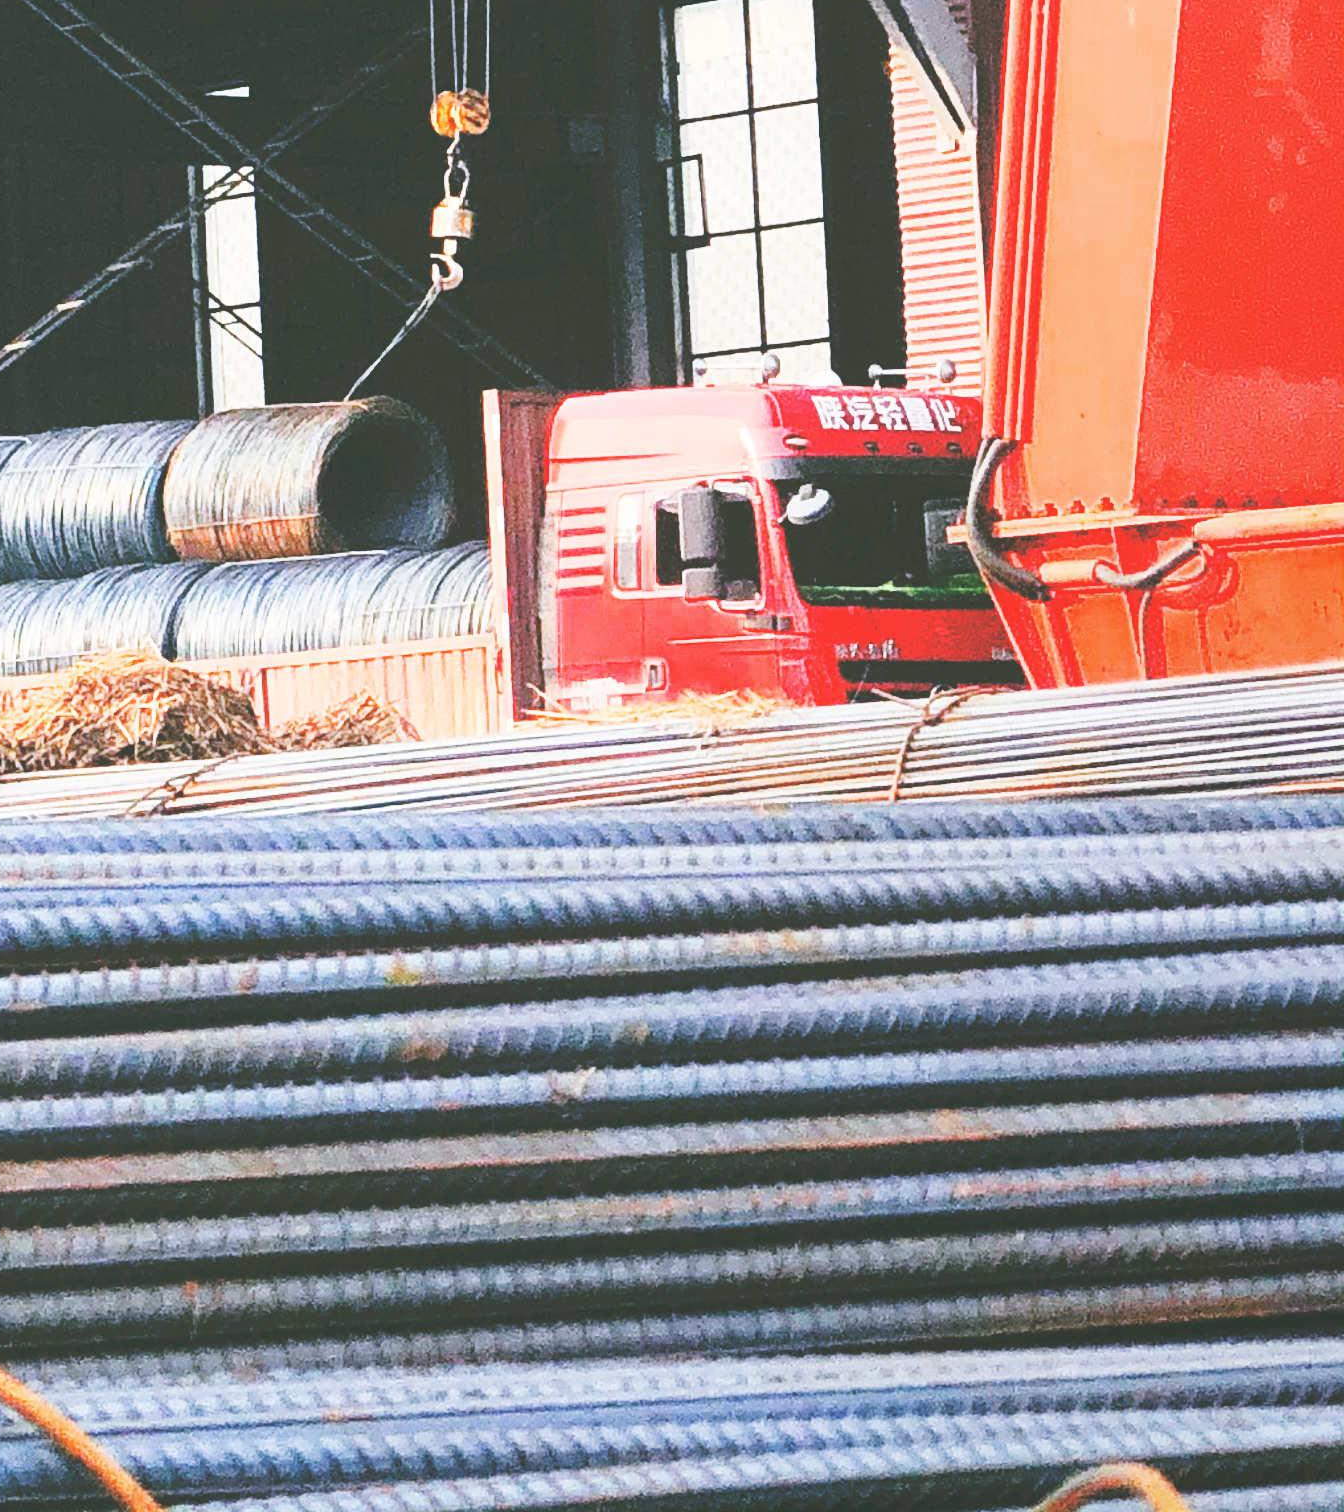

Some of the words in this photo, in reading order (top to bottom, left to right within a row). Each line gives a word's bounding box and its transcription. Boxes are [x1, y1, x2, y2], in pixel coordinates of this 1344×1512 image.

[812, 394, 963, 433] 陕汽轻量化
